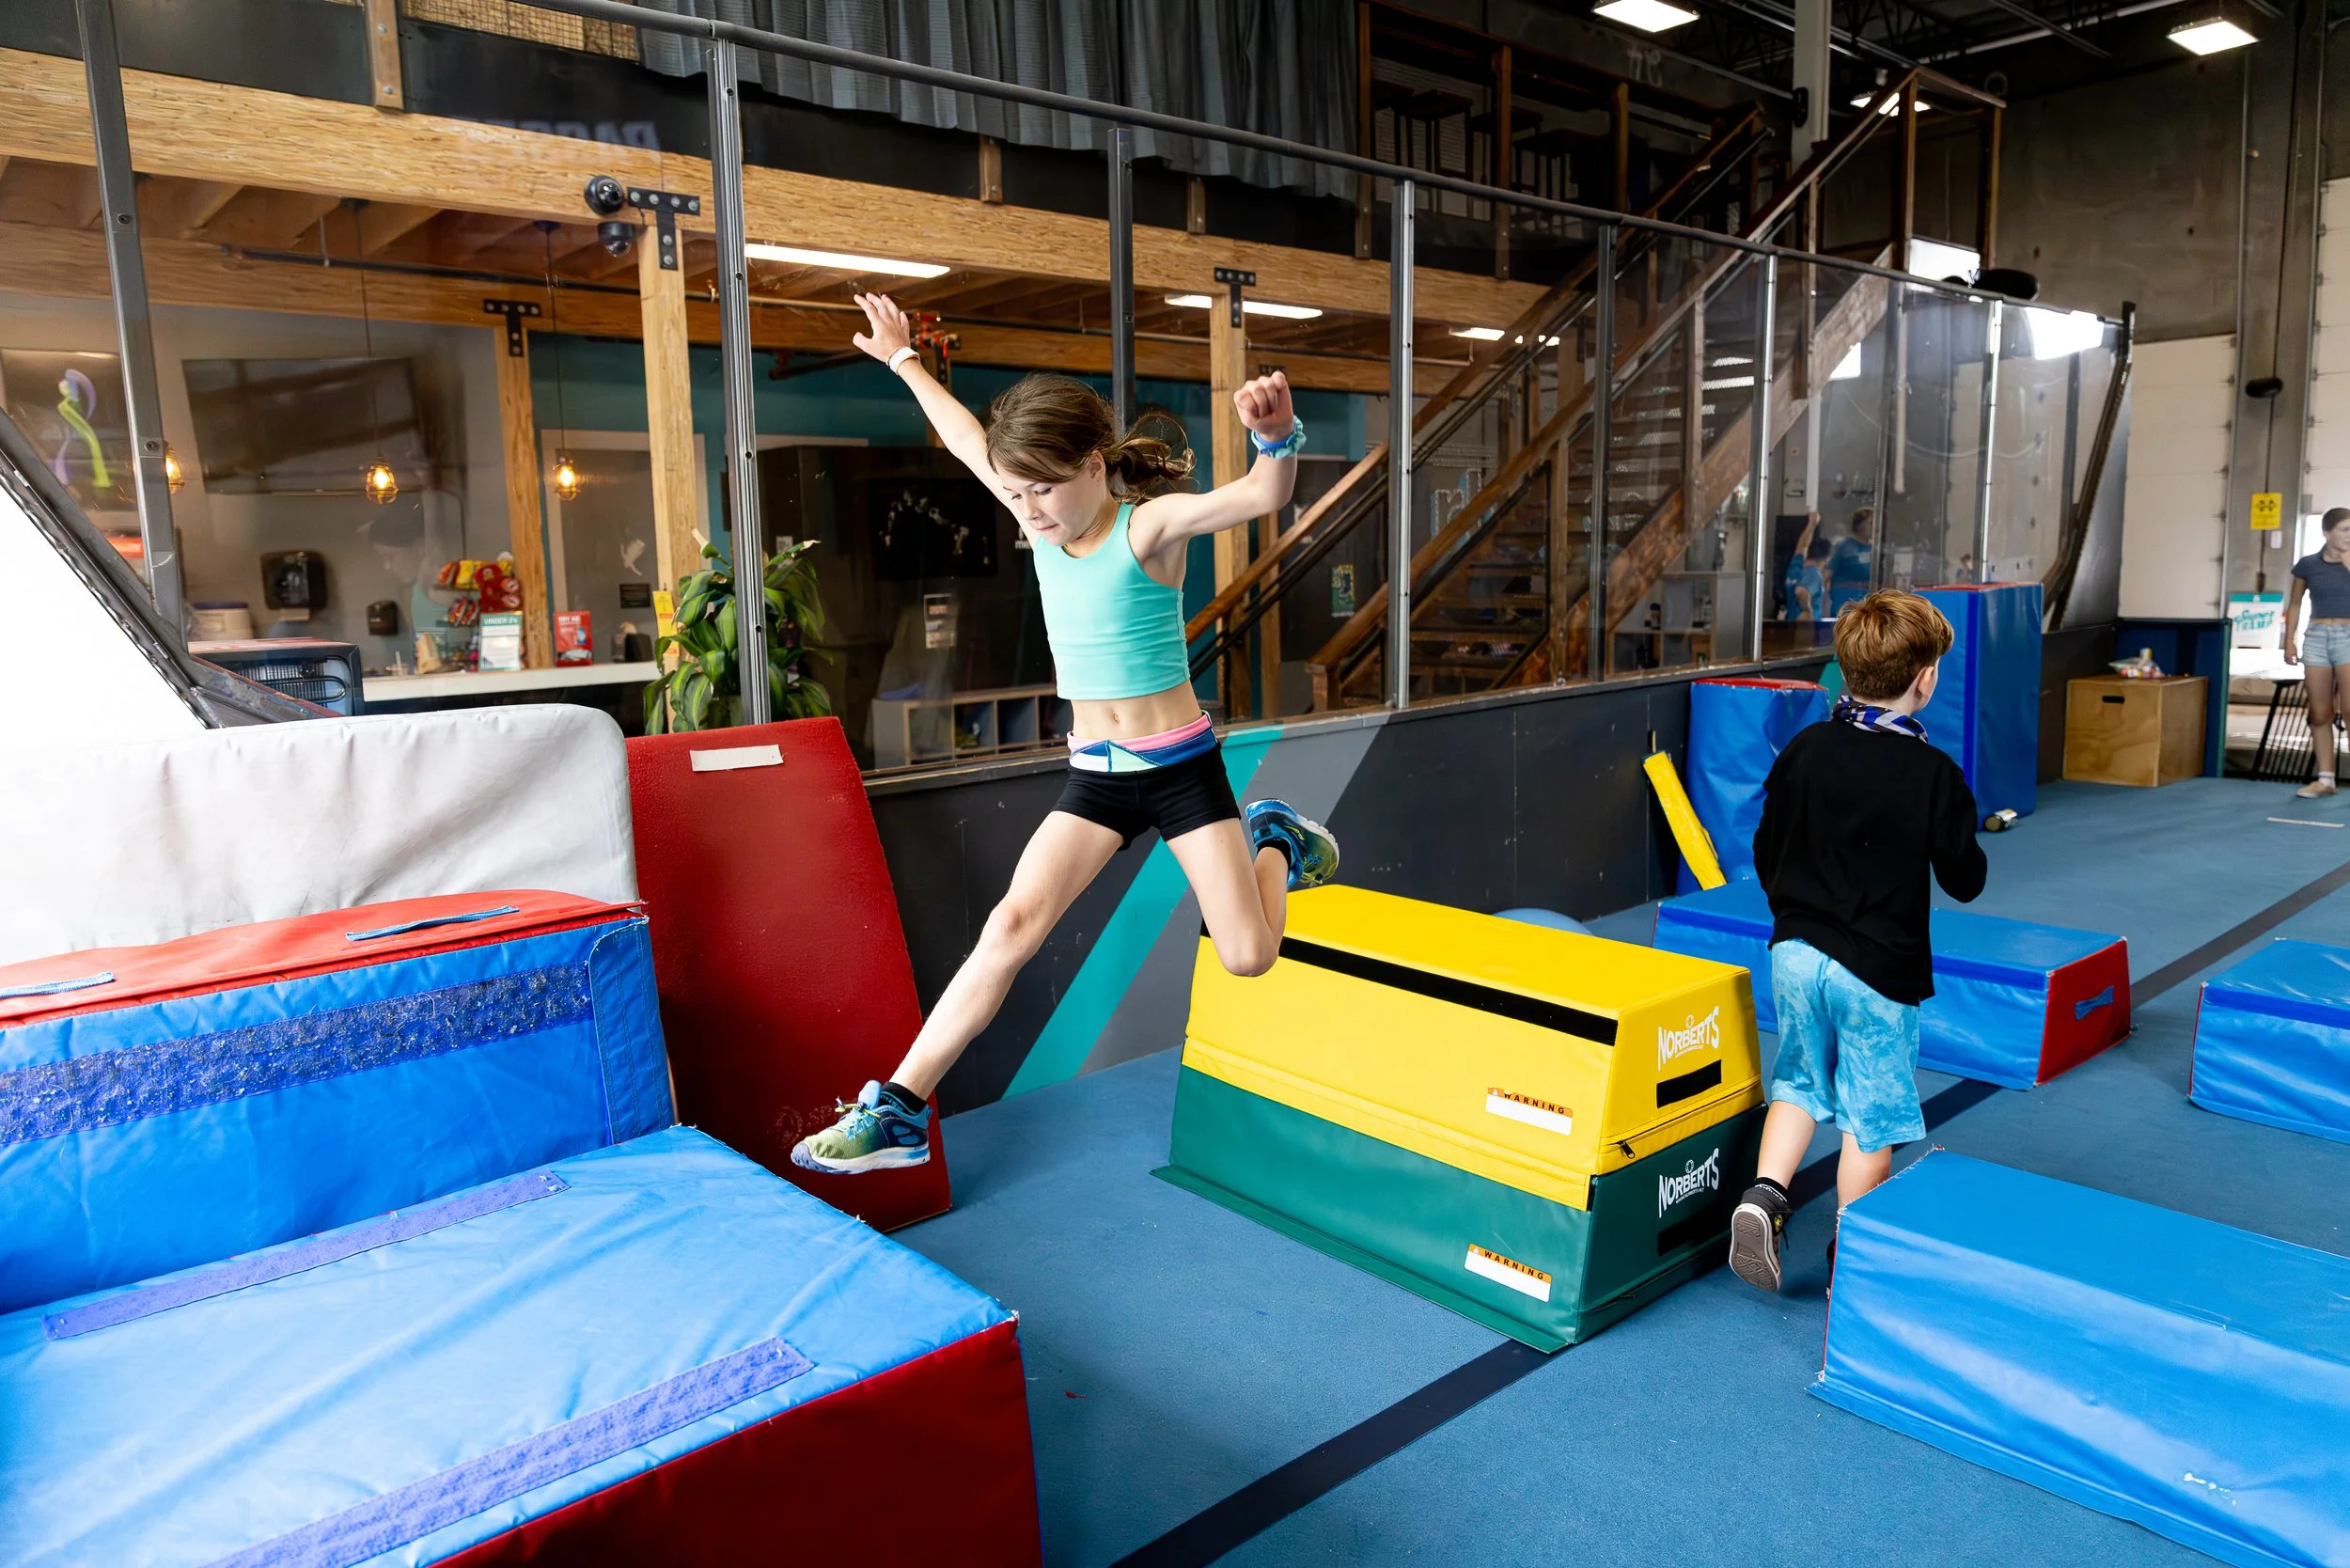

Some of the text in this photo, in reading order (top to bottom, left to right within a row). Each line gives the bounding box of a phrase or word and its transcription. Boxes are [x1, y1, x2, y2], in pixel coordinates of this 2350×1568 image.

[1657, 1006, 1719, 1072] NORBERTS
[1504, 1092, 1564, 1114] WARNING
[1658, 1148, 1719, 1218] NORBERTS
[1484, 1250, 1543, 1279] WARNING
